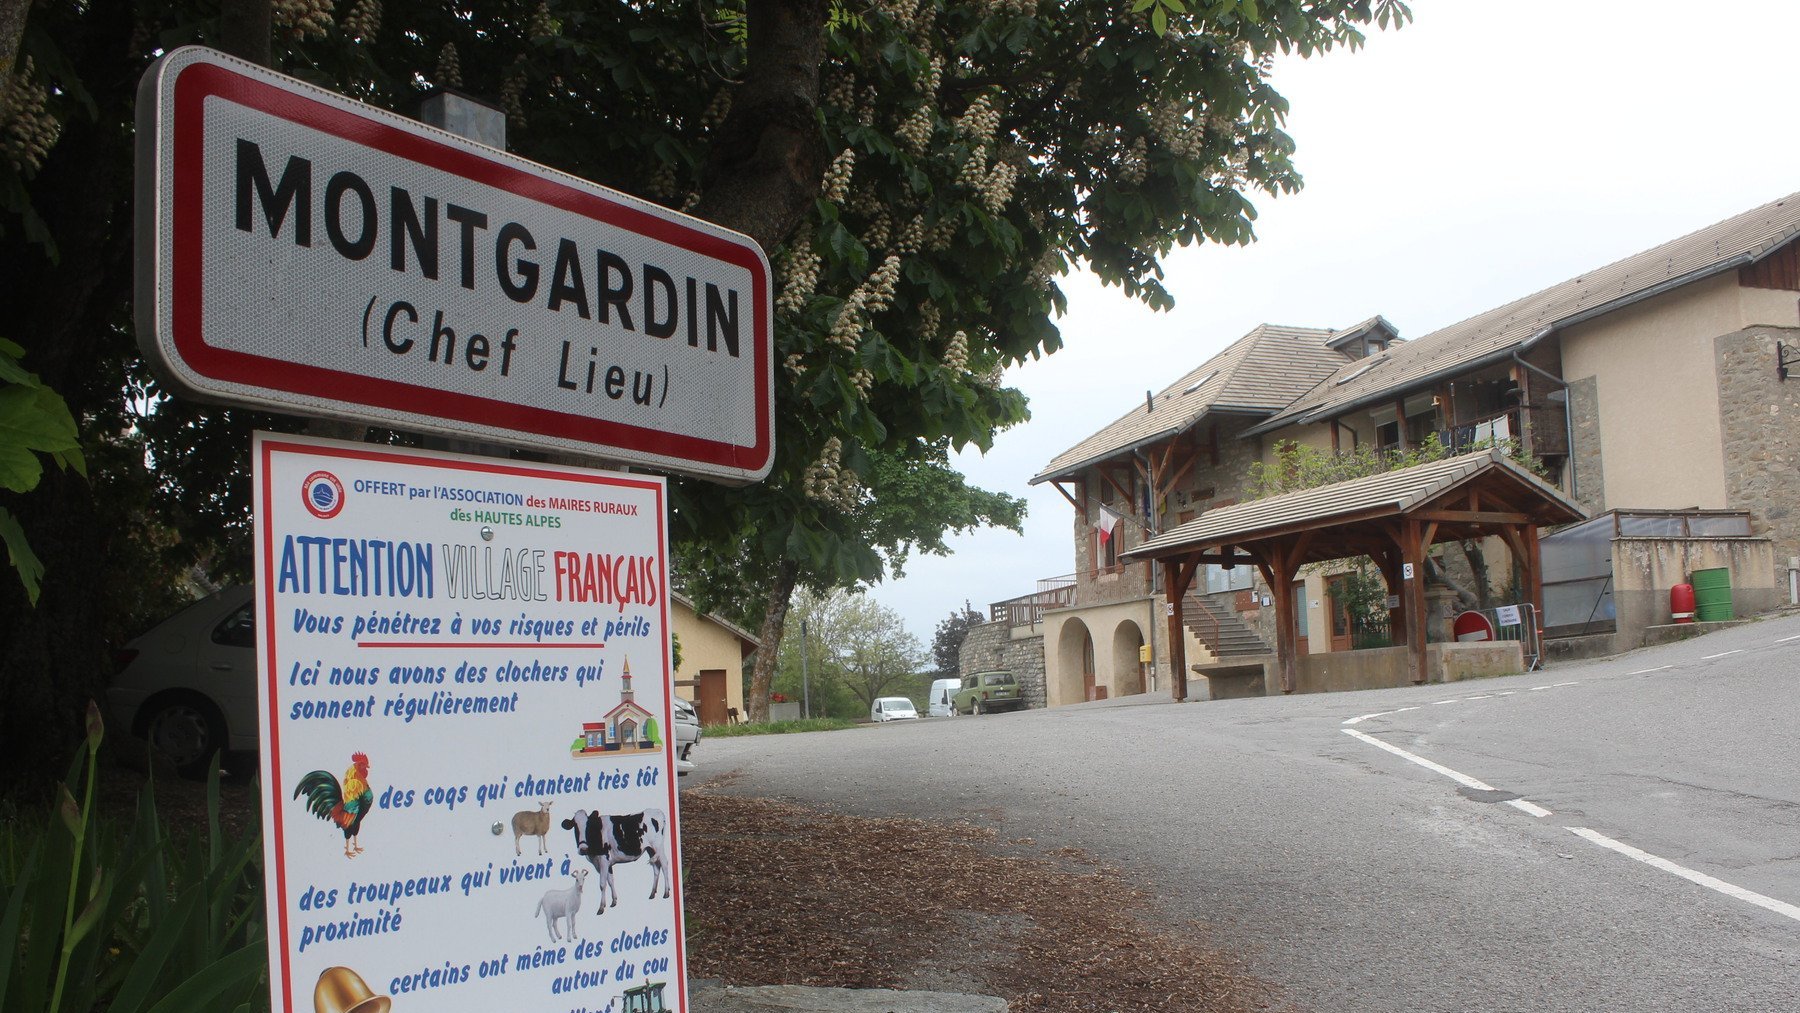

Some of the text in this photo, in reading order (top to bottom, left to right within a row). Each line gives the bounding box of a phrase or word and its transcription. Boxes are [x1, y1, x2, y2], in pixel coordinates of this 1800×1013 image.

[235, 138, 741, 357] MONTGARDIN
[362, 294, 669, 409] (Chef Lieu)
[354, 479, 406, 498] OFFERT
[409, 487, 431, 502] par
[526, 495, 546, 509] des
[549, 497, 591, 513] MAIRES
[593, 502, 638, 516] RURAUX
[450, 508, 562, 529] des HAUTES ALPES
[279, 535, 656, 612] ATTENTION VILLAGE FRANÇAIS
[294, 609, 650, 642] Vous pénétrez à vos risques et périls
[290, 660, 603, 687] Ici nous avons des clochers qui
[290, 691, 517, 723] sonnent régulièrement
[379, 768, 658, 810] des coqs qui chantent très tôt
[299, 854, 572, 911] des troupeaux qui vivent à
[299, 908, 401, 952] proximité
[390, 928, 667, 995] certains ont même des cloches
[552, 957, 669, 994] autour du cou
